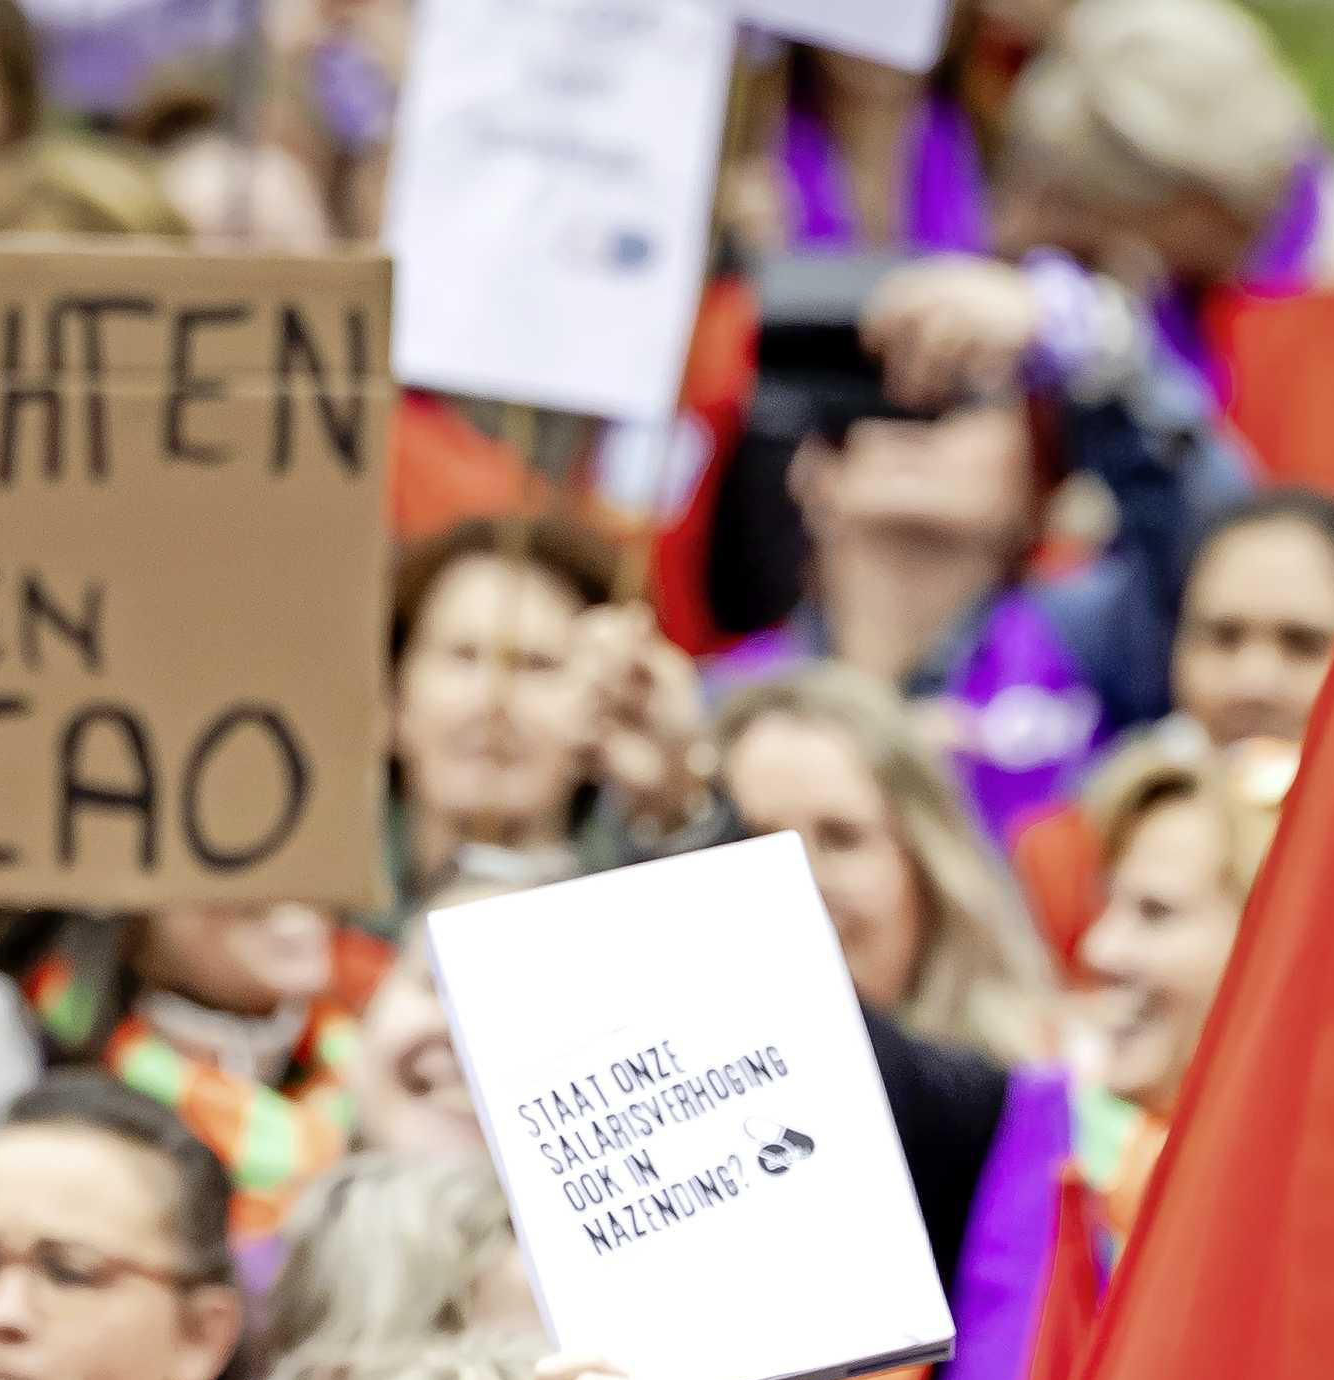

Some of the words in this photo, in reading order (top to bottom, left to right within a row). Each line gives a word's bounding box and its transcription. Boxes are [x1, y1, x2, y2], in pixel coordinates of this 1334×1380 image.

[518, 1074, 609, 1138] STAAT
[611, 1040, 686, 1094] ONZE
[540, 1046, 788, 1175] SALARISVERHOGING
[563, 1165, 624, 1212] OOK
[624, 1149, 660, 1187] IN
[583, 1154, 750, 1256] NAZENDING?
